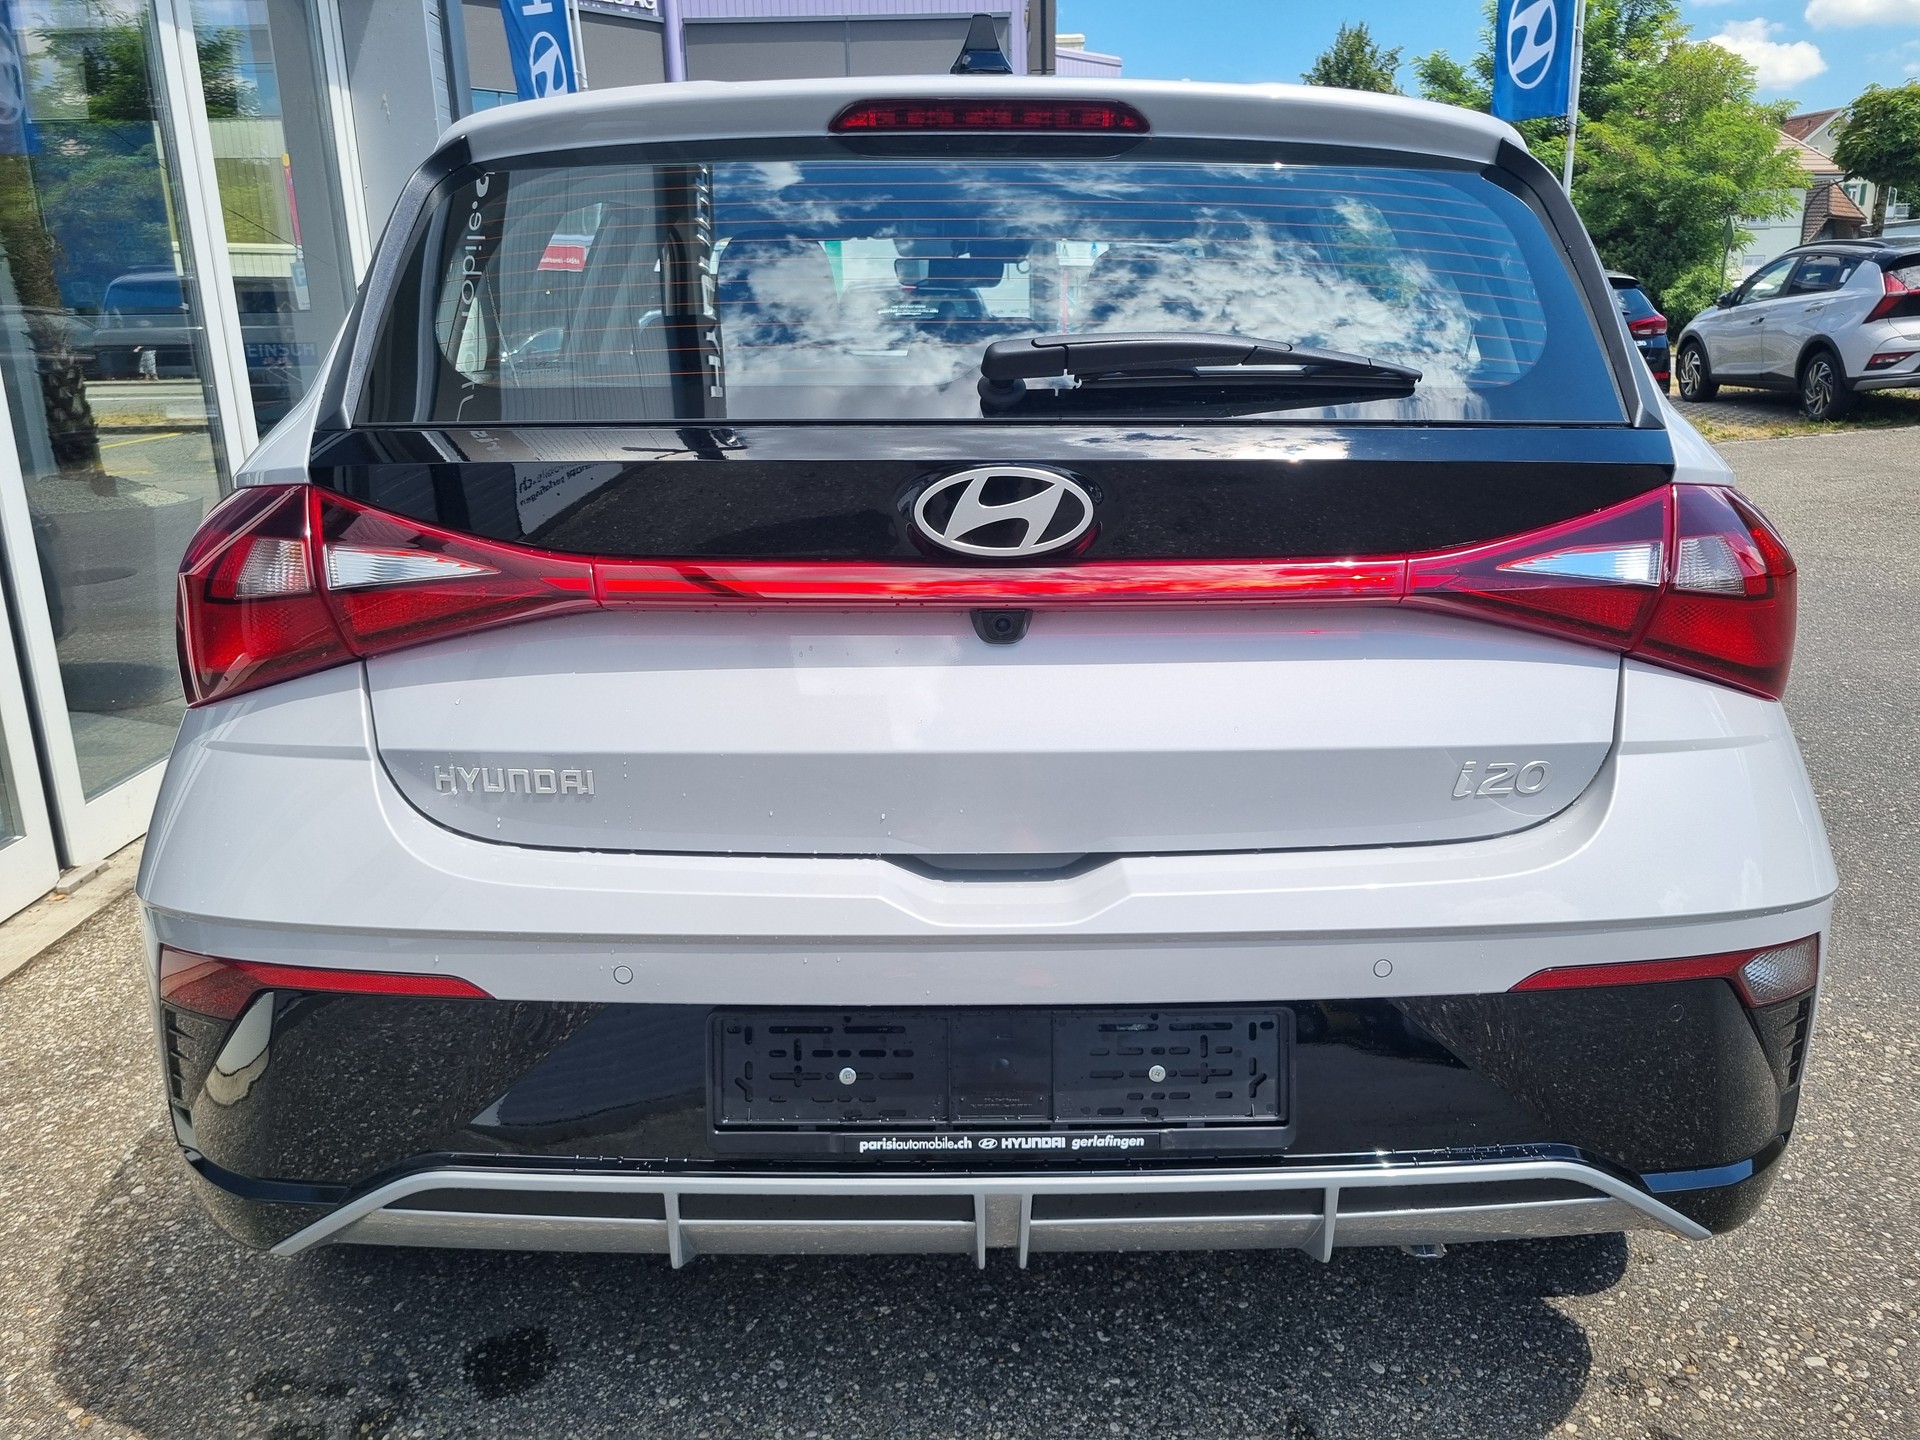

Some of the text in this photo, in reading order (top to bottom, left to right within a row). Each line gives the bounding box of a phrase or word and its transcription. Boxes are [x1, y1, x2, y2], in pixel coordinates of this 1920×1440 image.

[433, 764, 596, 796] HYUNDAI
[1451, 759, 1554, 798] i20
[859, 1134, 1145, 1153] parisiautomobile.ch HYUNDAI gerlafingen
